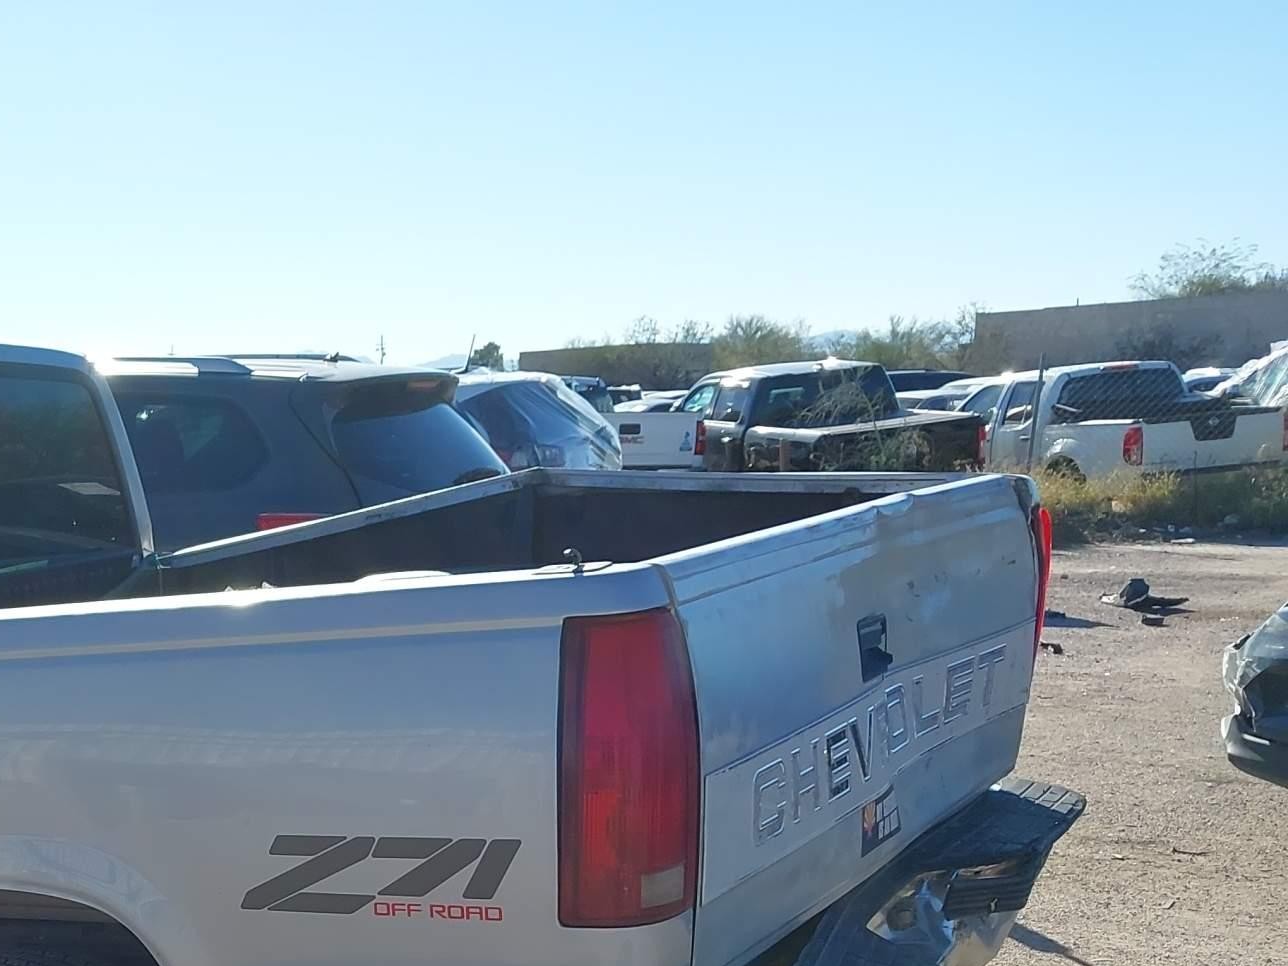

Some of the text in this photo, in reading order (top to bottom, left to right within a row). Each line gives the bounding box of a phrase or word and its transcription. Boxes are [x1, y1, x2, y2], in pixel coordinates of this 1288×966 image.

[752, 643, 1008, 847] CHEVOLET
[240, 834, 522, 915] Z71
[373, 902, 503, 921] OFF ROAD
